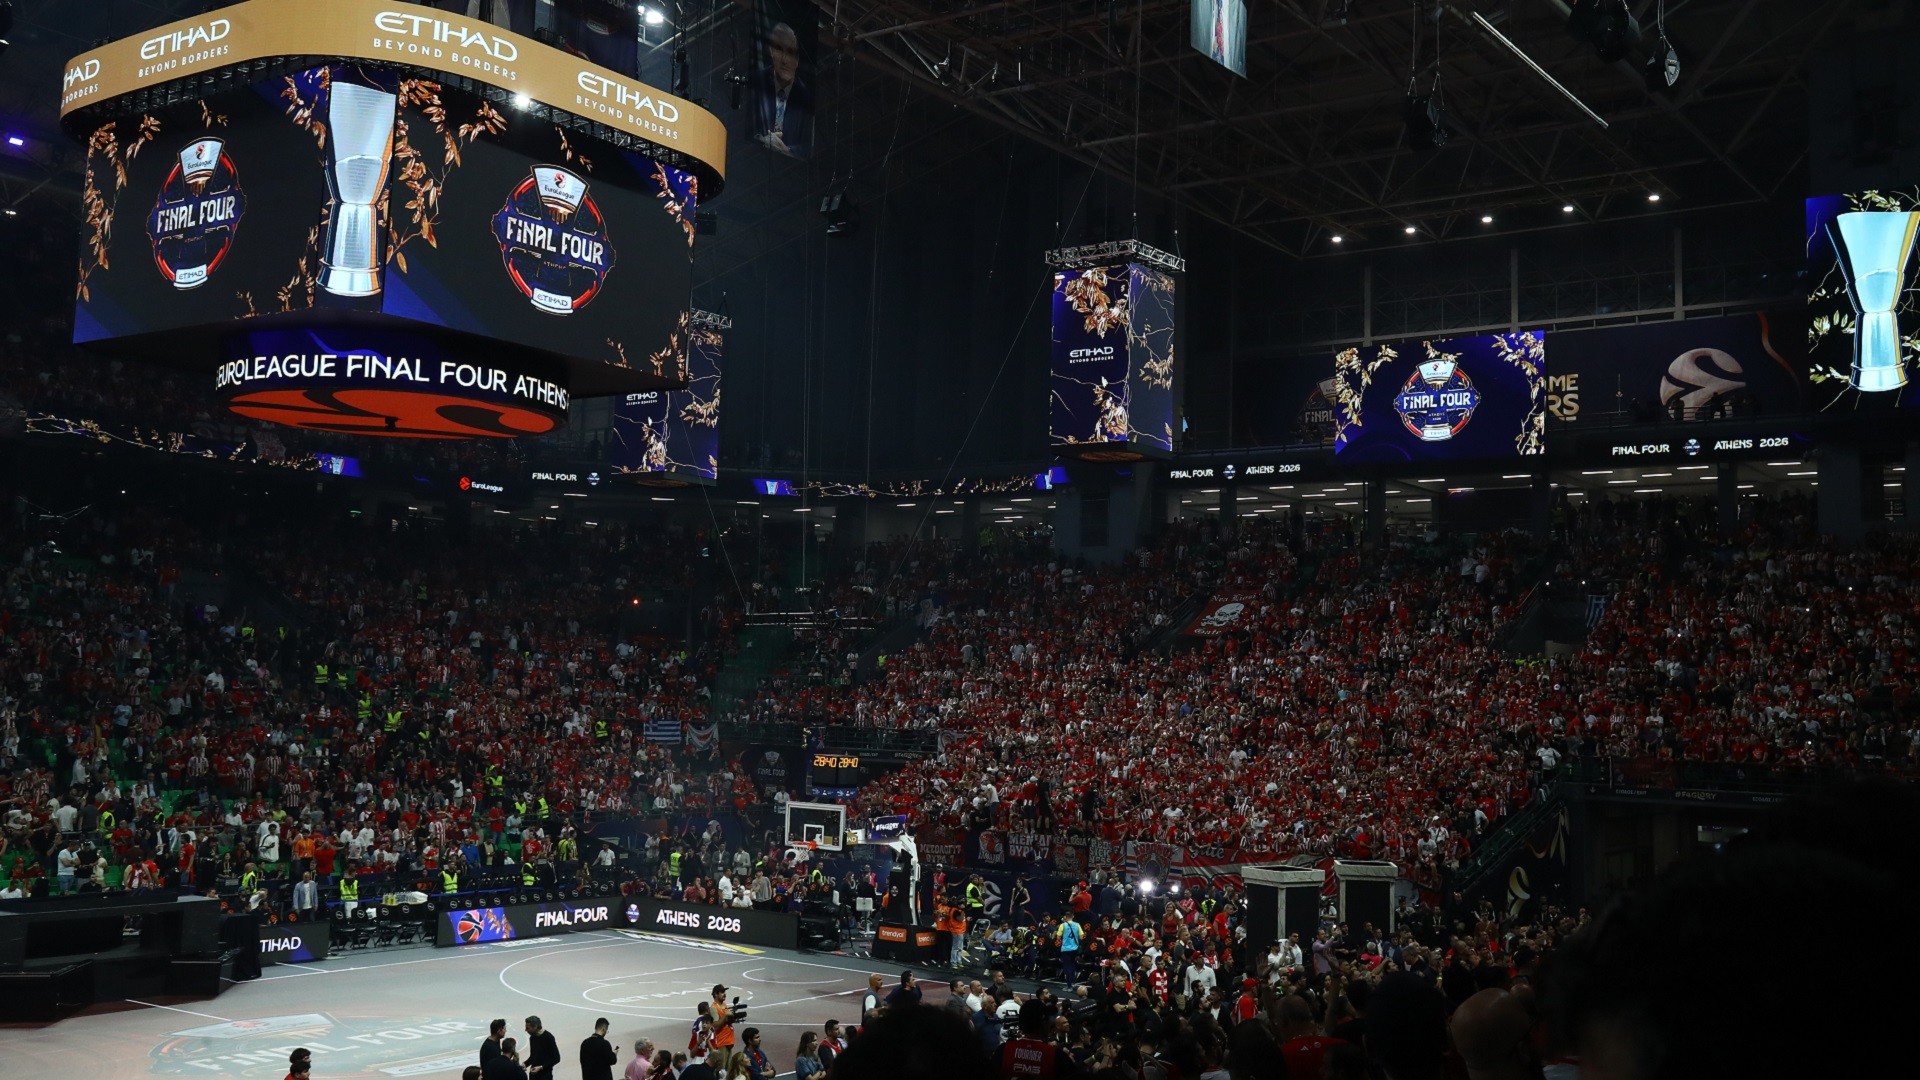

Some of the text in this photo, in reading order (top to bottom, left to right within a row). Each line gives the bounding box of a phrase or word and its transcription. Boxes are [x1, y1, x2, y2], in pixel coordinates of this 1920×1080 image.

[140, 19, 230, 60] ETIHAD
[374, 11, 518, 62] ETIHAD
[138, 45, 229, 78] BEYOND BORDERS
[373, 38, 518, 81] BEYOND BORDERS
[65, 84, 99, 104] BORDERS
[576, 70, 679, 123] ETIHAD
[576, 95, 679, 140] BEYOND BORDERS
[544, 185, 575, 200] EuroLeague
[199, 195, 236, 225] FOUR
[561, 232, 604, 266] FOUR
[178, 270, 204, 280] ETIHAD
[537, 294, 569, 307] ETIHAD
[1070, 346, 1114, 358] ETIHAD
[218, 354, 567, 410] EUROLEAGUE FINAL FOUR ATHENS
[1548, 373, 1579, 392] ME
[626, 391, 658, 401] ETIHAD
[1440, 392, 1471, 407] FOUR
[1548, 393, 1580, 418] RS
[1612, 444, 1670, 456] FINAL FOUR
[1714, 437, 1789, 450] ATHENS 2026
[532, 472, 577, 482] FINAL FOUR
[1170, 468, 1213, 479] FINAL FOUR
[1246, 463, 1301, 475] ATHENS 2026
[471, 481, 503, 493] EuroLeague
[535, 906, 608, 928] FINAL FOUR
[656, 908, 741, 933] ATHENS 2026
[881, 929, 904, 939] trendyol
[260, 936, 302, 953] TIHAD
[347, 1019, 487, 1045] FOUR
